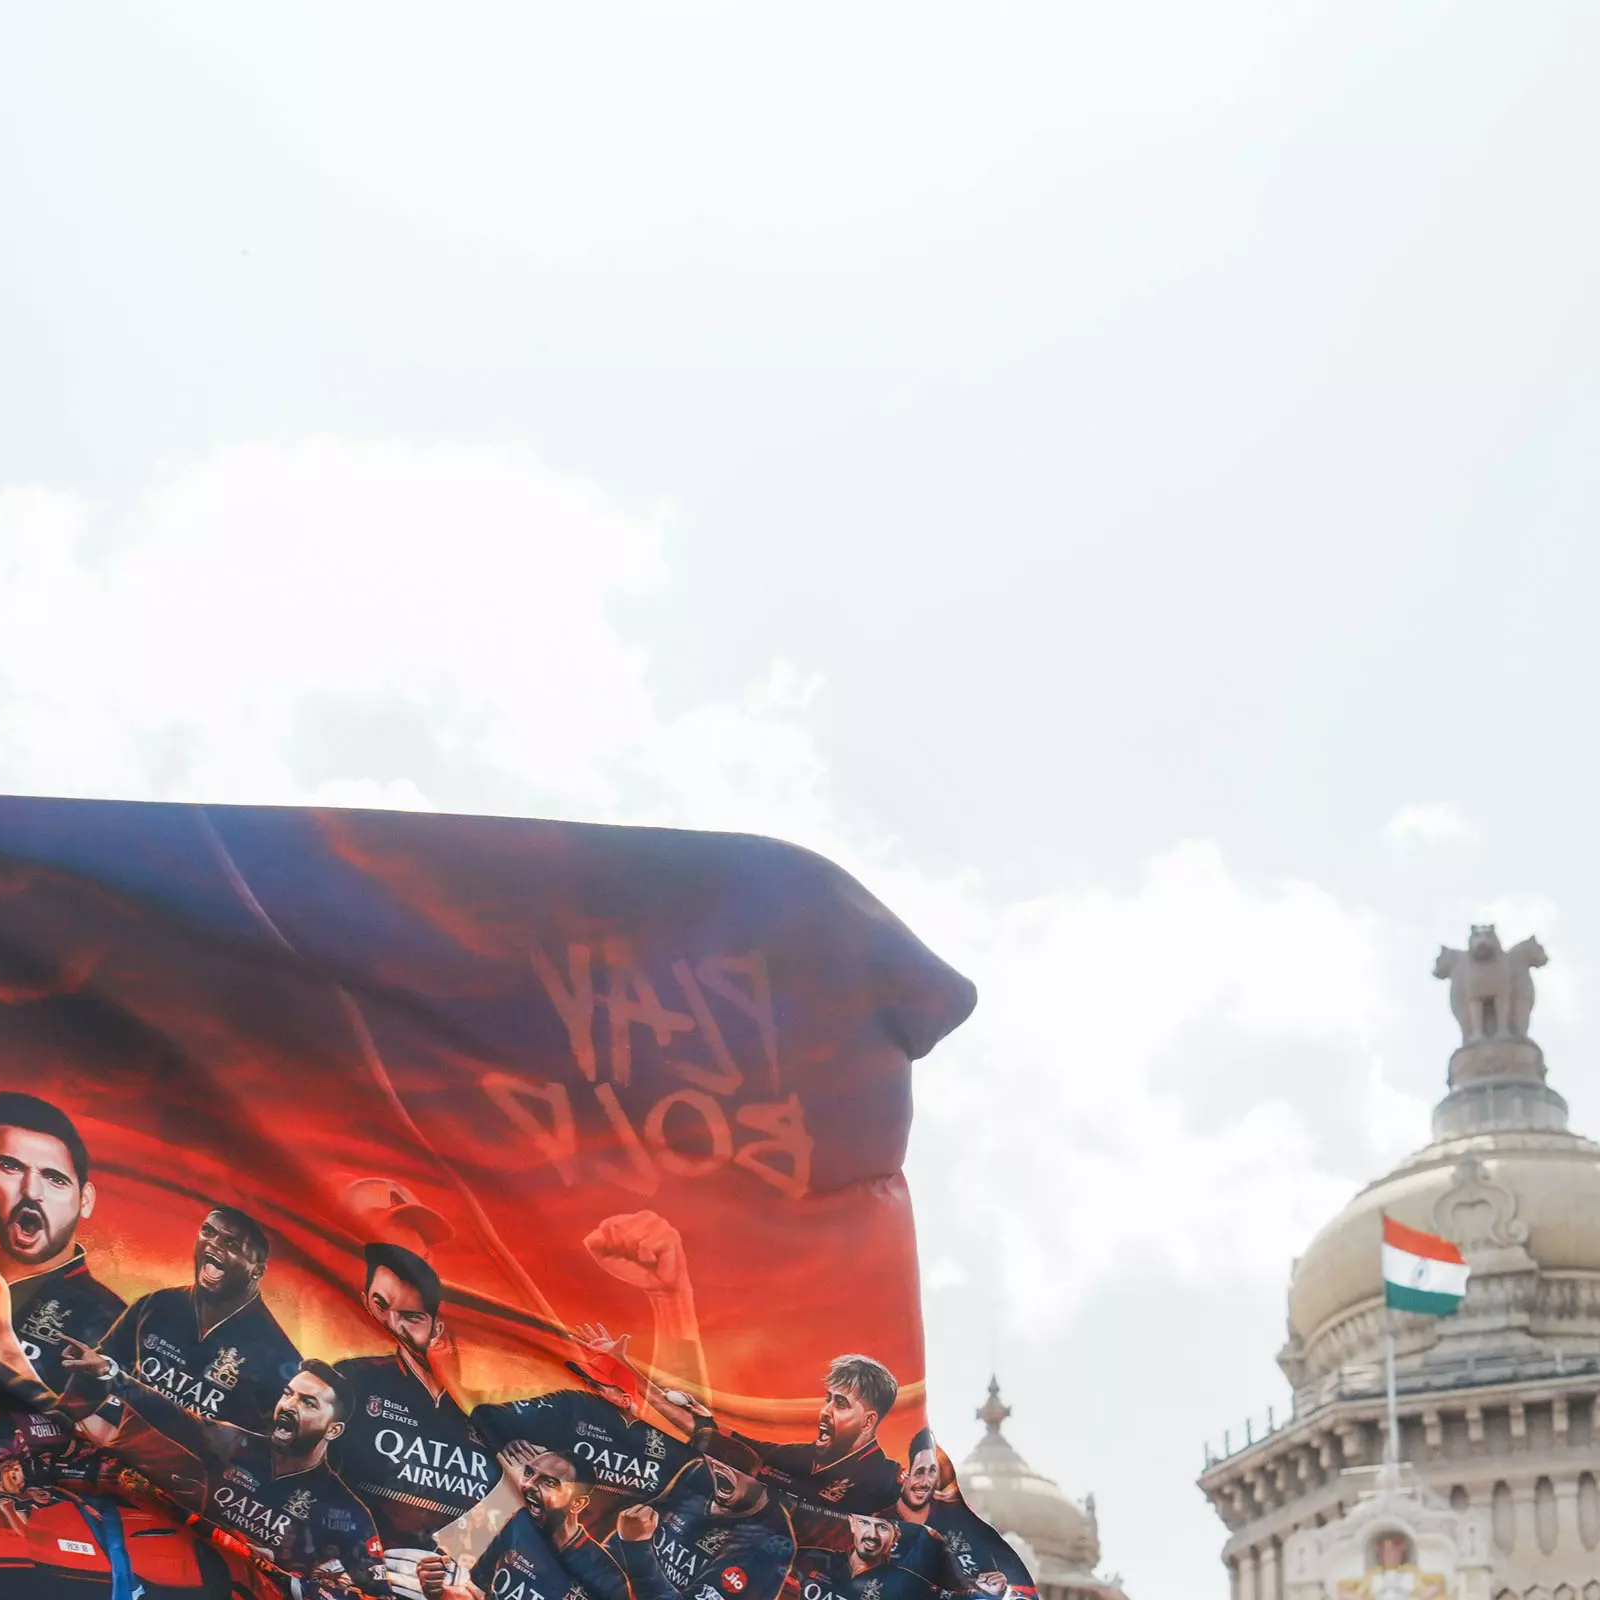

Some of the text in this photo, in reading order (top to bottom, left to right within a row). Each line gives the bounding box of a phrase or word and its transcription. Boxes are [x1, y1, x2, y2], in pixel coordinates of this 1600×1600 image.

[141, 1356, 225, 1413] QATAR
[382, 1410, 418, 1427] ESTATES
[384, 1400, 409, 1413] BIRLA
[374, 1429, 489, 1482] QATAR
[397, 1463, 489, 1501] AIRWAYS
[213, 1486, 291, 1535] QATAR
[221, 1509, 284, 1547] AIRWAYS
[652, 1527, 709, 1576] QATA
[724, 1571, 744, 1590] Jio
